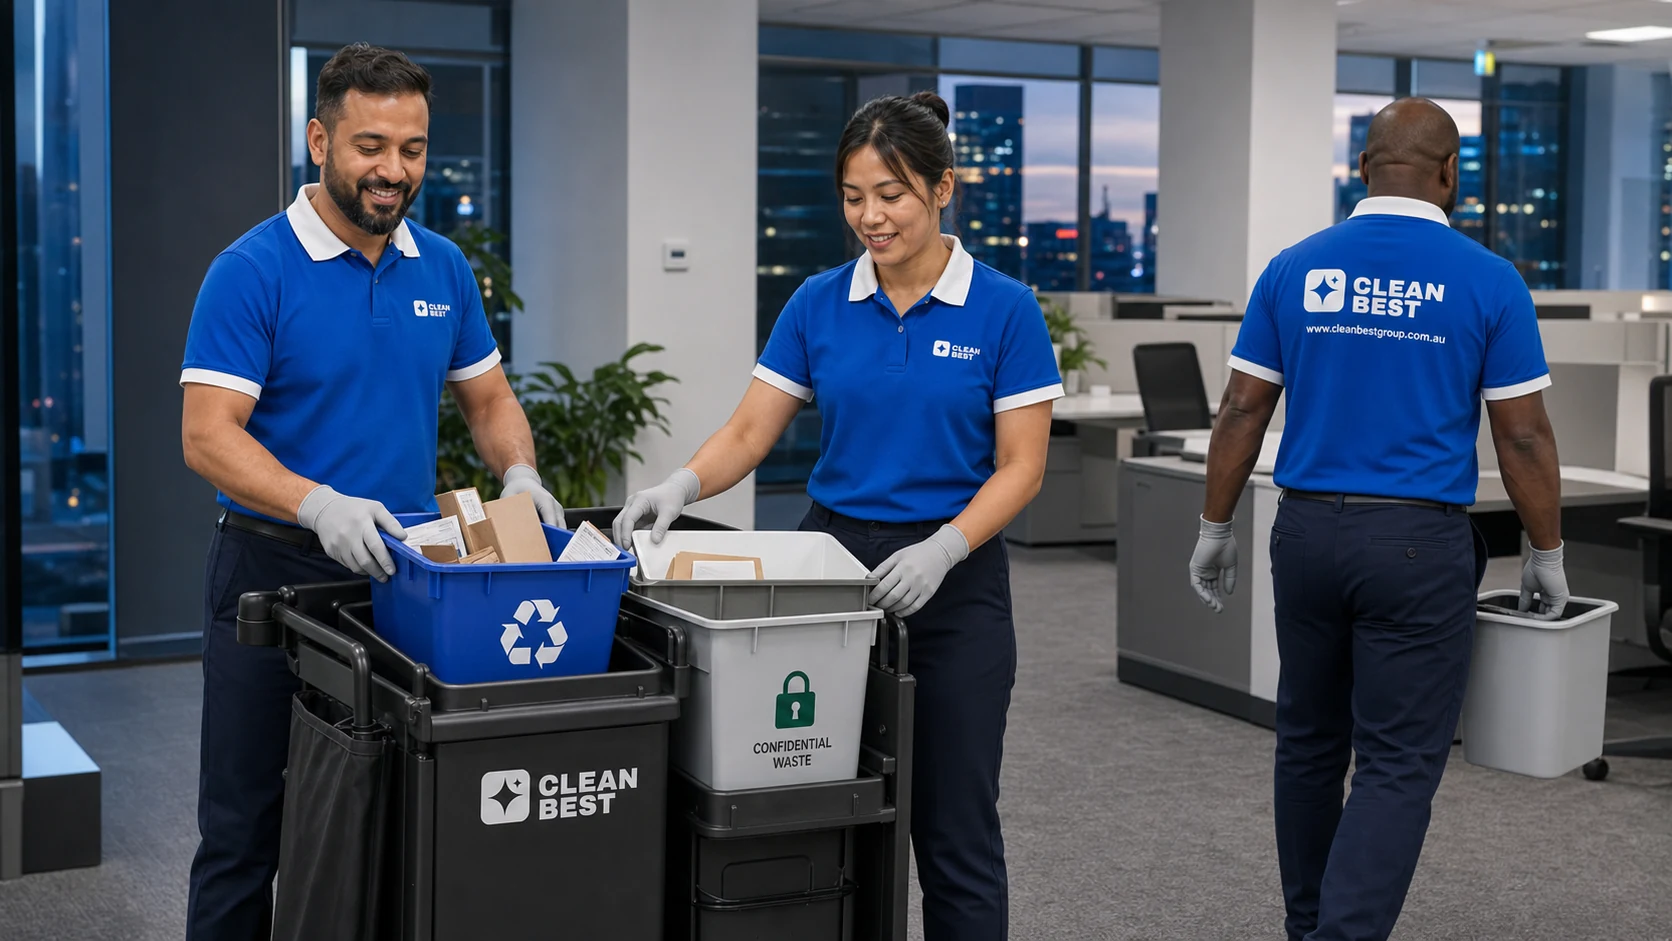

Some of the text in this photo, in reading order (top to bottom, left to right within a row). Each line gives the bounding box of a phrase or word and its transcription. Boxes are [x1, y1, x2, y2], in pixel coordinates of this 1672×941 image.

[1353, 277, 1445, 302] CLEAN
[428, 303, 451, 311] CLEAN
[1352, 295, 1421, 318] BEST
[1306, 323, 1446, 344] www.cleanbestgroup.com.au
[951, 344, 981, 355] CLEAN
[753, 737, 832, 754] CONFIDENTIAL
[773, 754, 812, 769] WASTE
[538, 767, 638, 797] CLEAN
[538, 792, 616, 821] BEST
